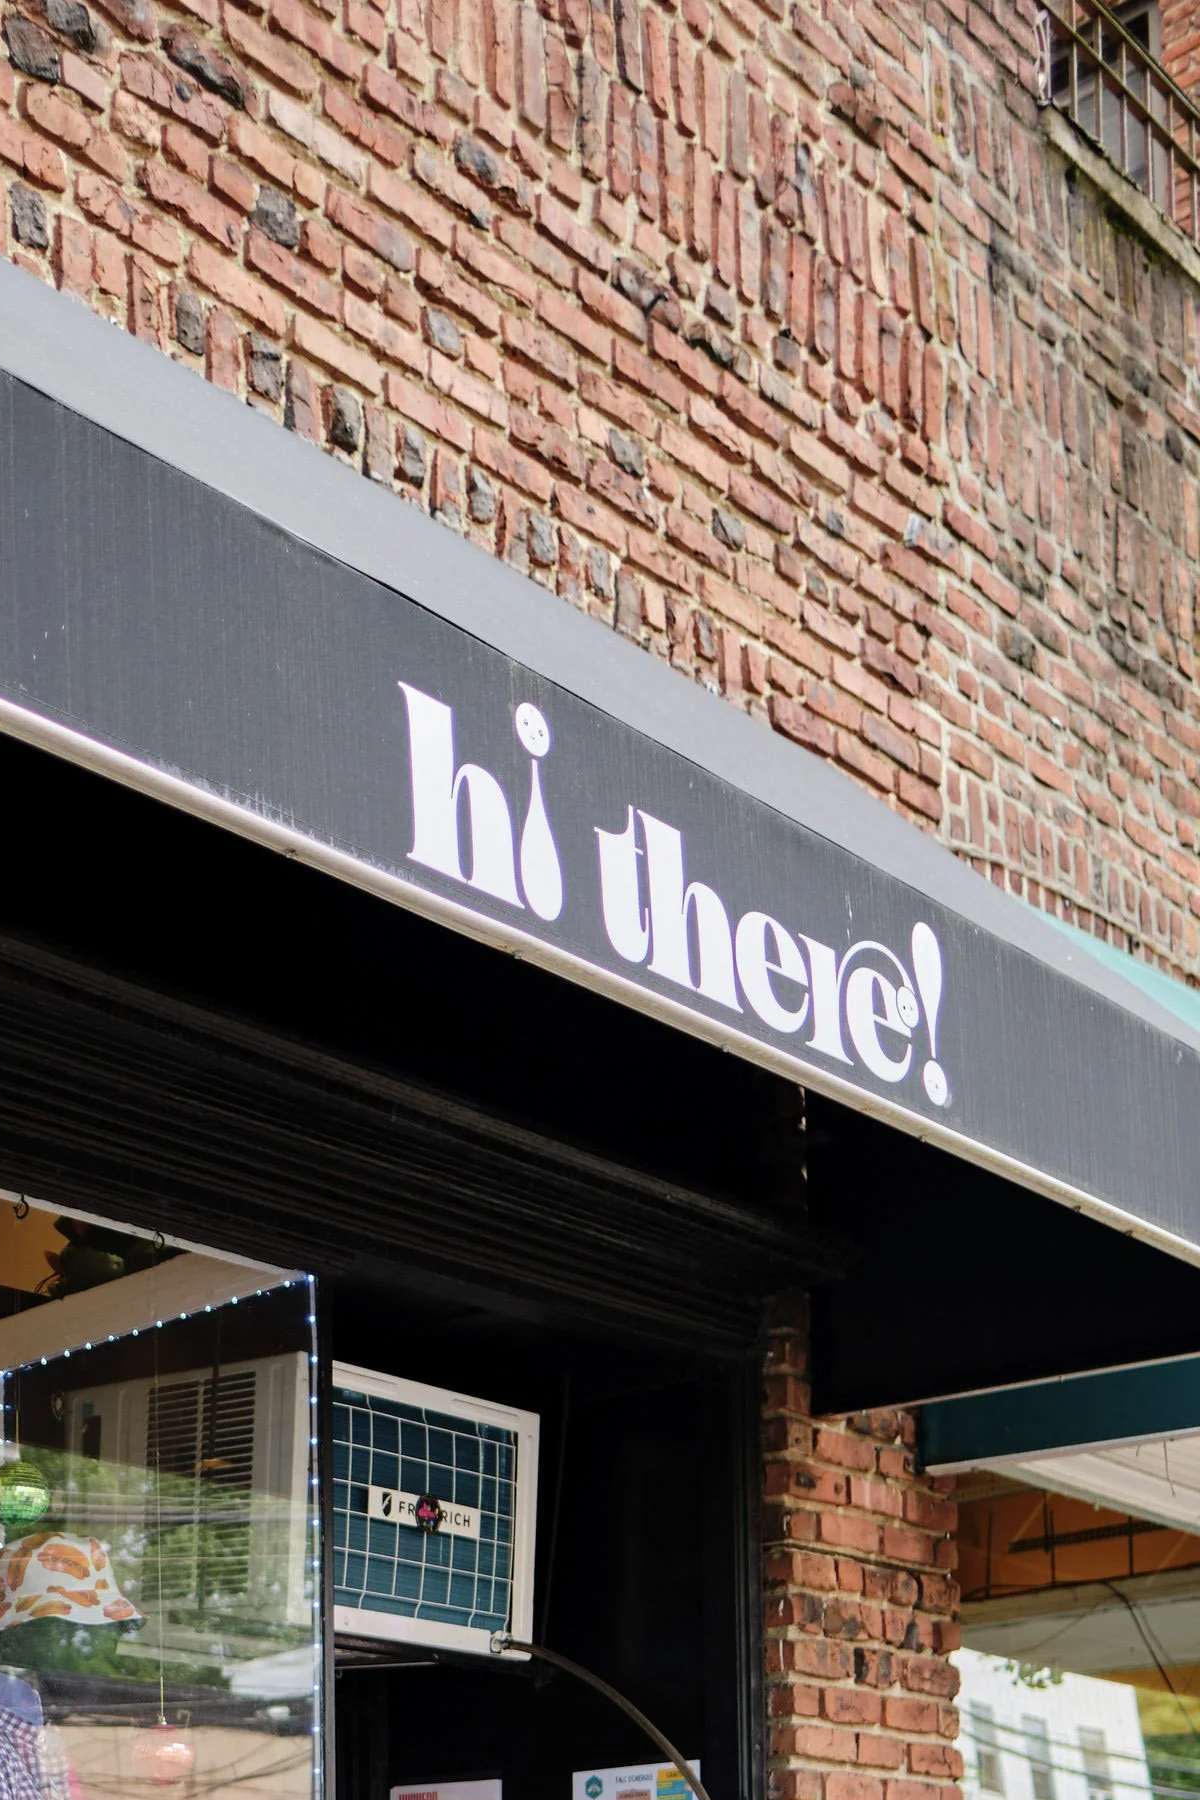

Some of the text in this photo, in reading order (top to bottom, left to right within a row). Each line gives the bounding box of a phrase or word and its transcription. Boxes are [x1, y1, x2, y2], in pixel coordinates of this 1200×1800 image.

[398, 680, 951, 1107] hi there!
[399, 1501, 471, 1528] FRRICH
